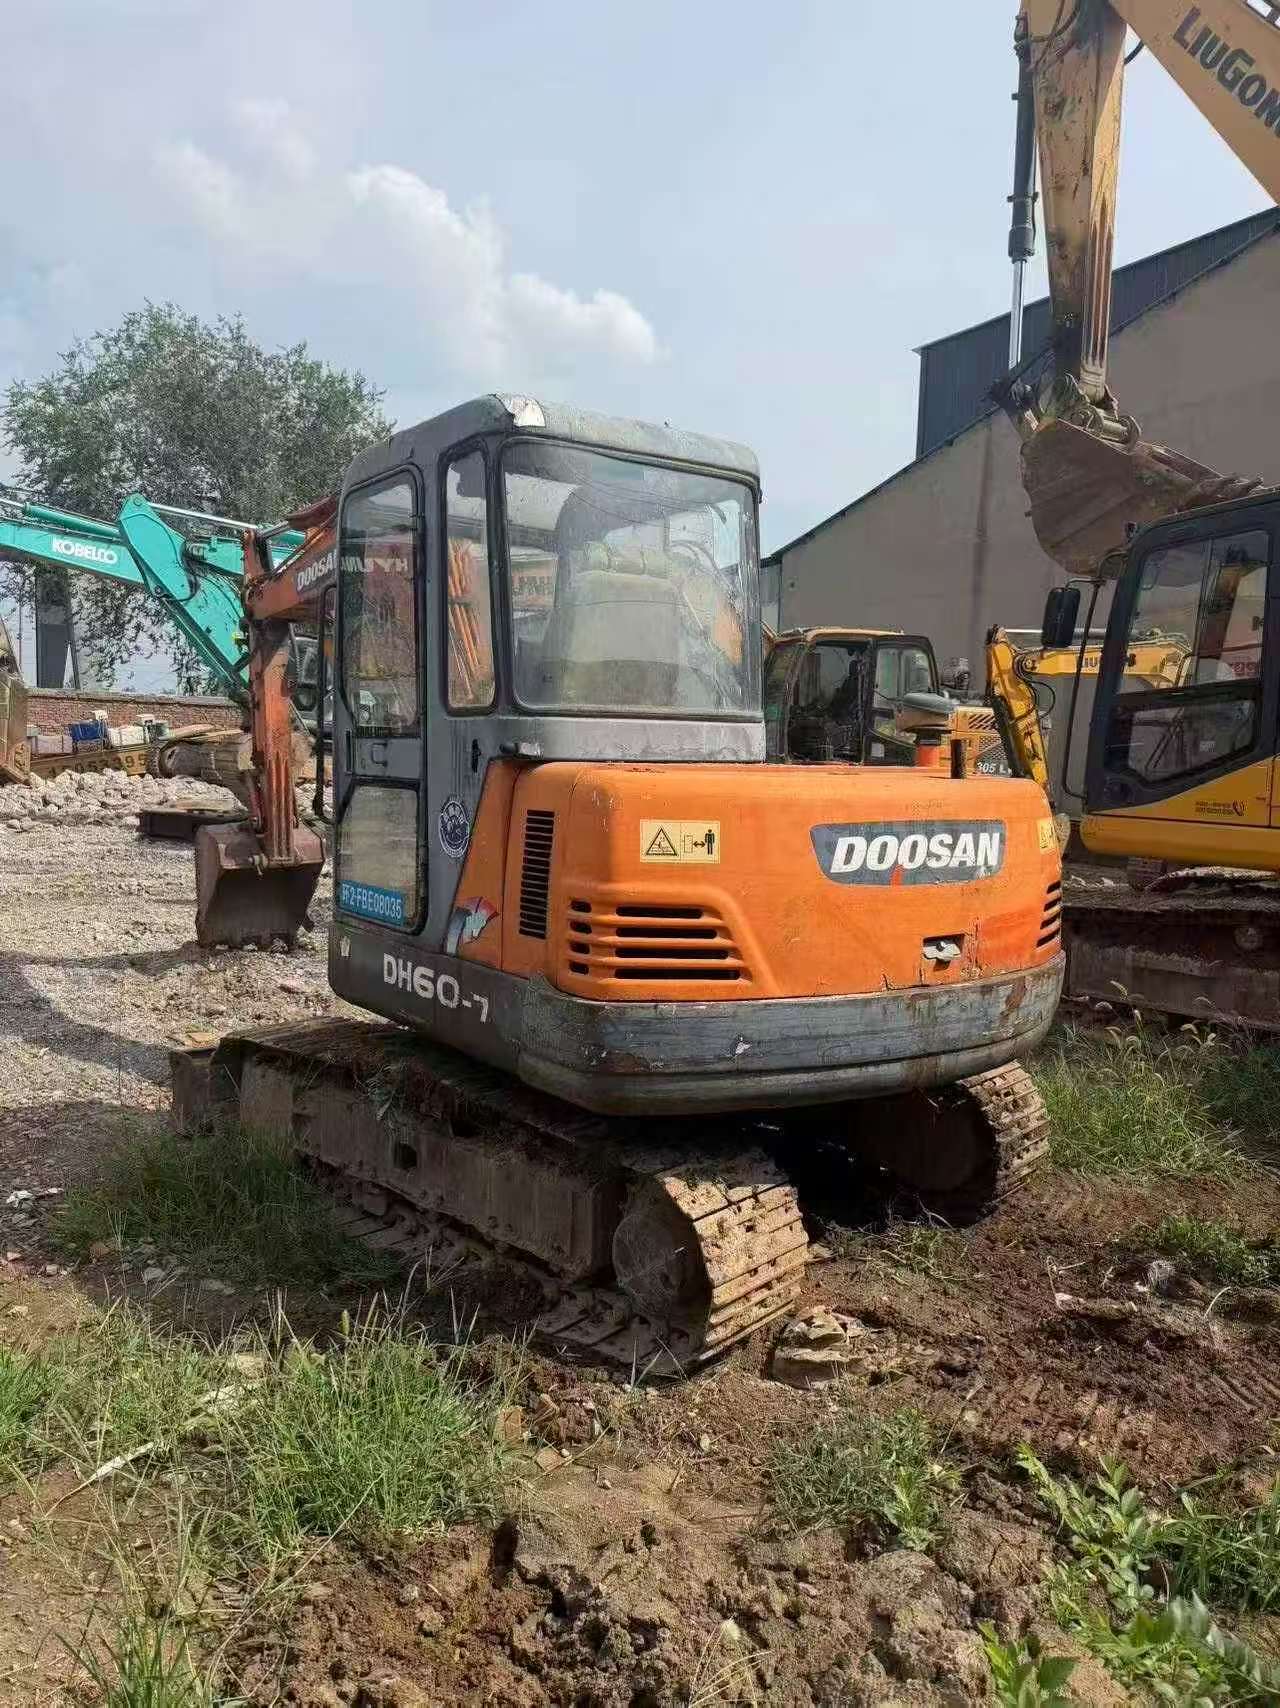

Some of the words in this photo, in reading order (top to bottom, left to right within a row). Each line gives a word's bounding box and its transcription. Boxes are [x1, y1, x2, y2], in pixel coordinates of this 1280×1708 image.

[1173, 6, 1280, 138] LIUGON
[52, 536, 119, 565] KOBELCO
[297, 548, 338, 592] DOOSA
[830, 832, 1000, 873] DOOSAN
[383, 953, 489, 1024] DH60-7
